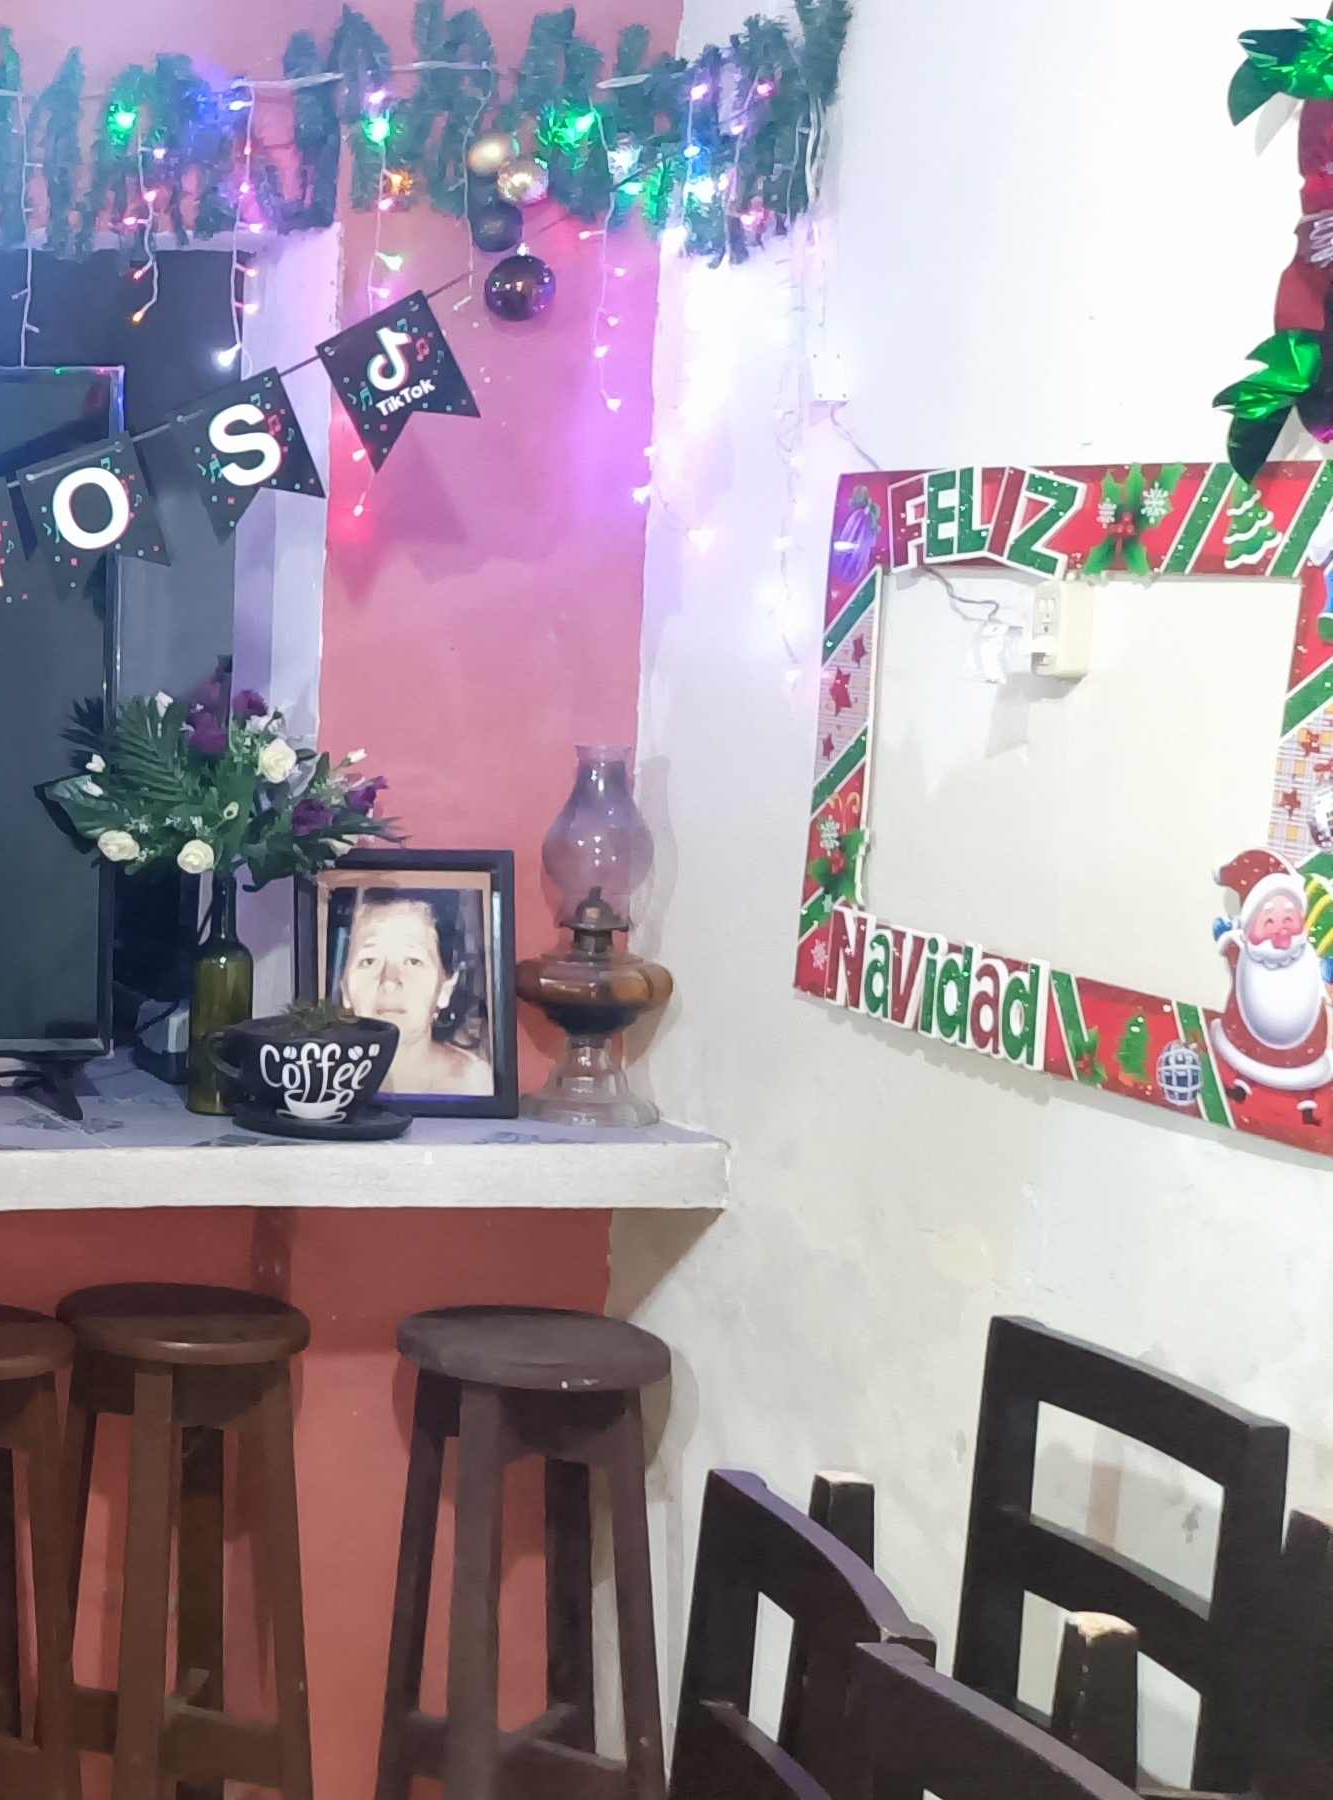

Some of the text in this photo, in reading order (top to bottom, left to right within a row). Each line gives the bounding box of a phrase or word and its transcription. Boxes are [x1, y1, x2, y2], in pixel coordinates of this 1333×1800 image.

[376, 378, 437, 417] TikTok
[887, 466, 1087, 579] FELIZ
[826, 903, 1048, 1073] Navidad
[260, 1043, 373, 1103] Coffee
